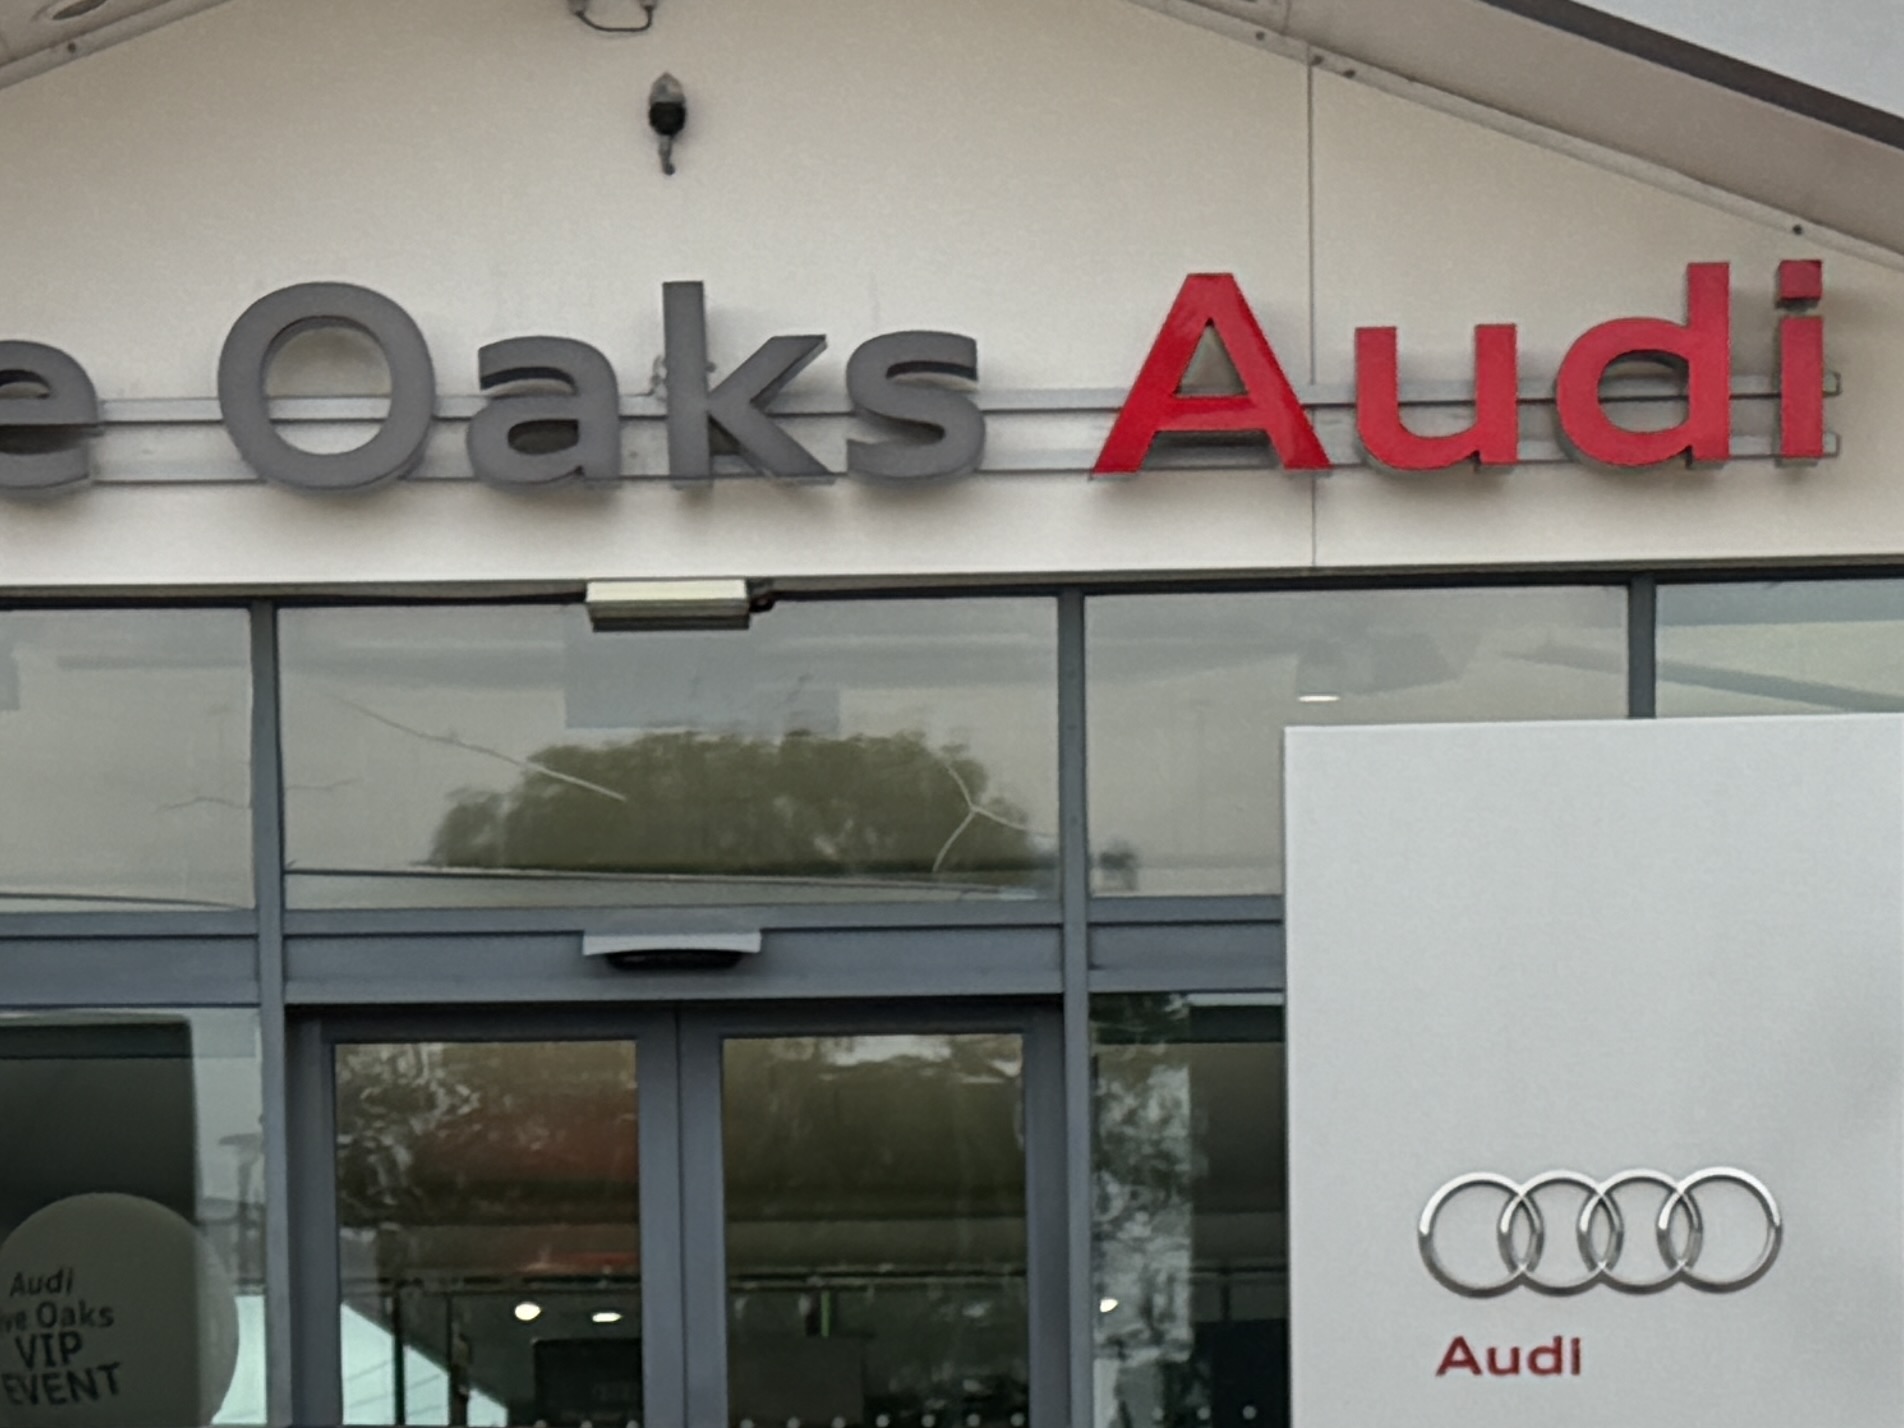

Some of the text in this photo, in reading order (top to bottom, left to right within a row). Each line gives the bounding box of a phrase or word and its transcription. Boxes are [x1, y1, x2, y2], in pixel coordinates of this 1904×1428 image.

[218, 281, 986, 491] Oaks
[1091, 260, 1825, 475] Audi
[10, 1267, 74, 1296] Audi
[36, 1300, 115, 1328] Oaks
[15, 1331, 83, 1370] VIP
[1437, 1336, 1582, 1376] Audi
[1, 1361, 121, 1406] EVENT
